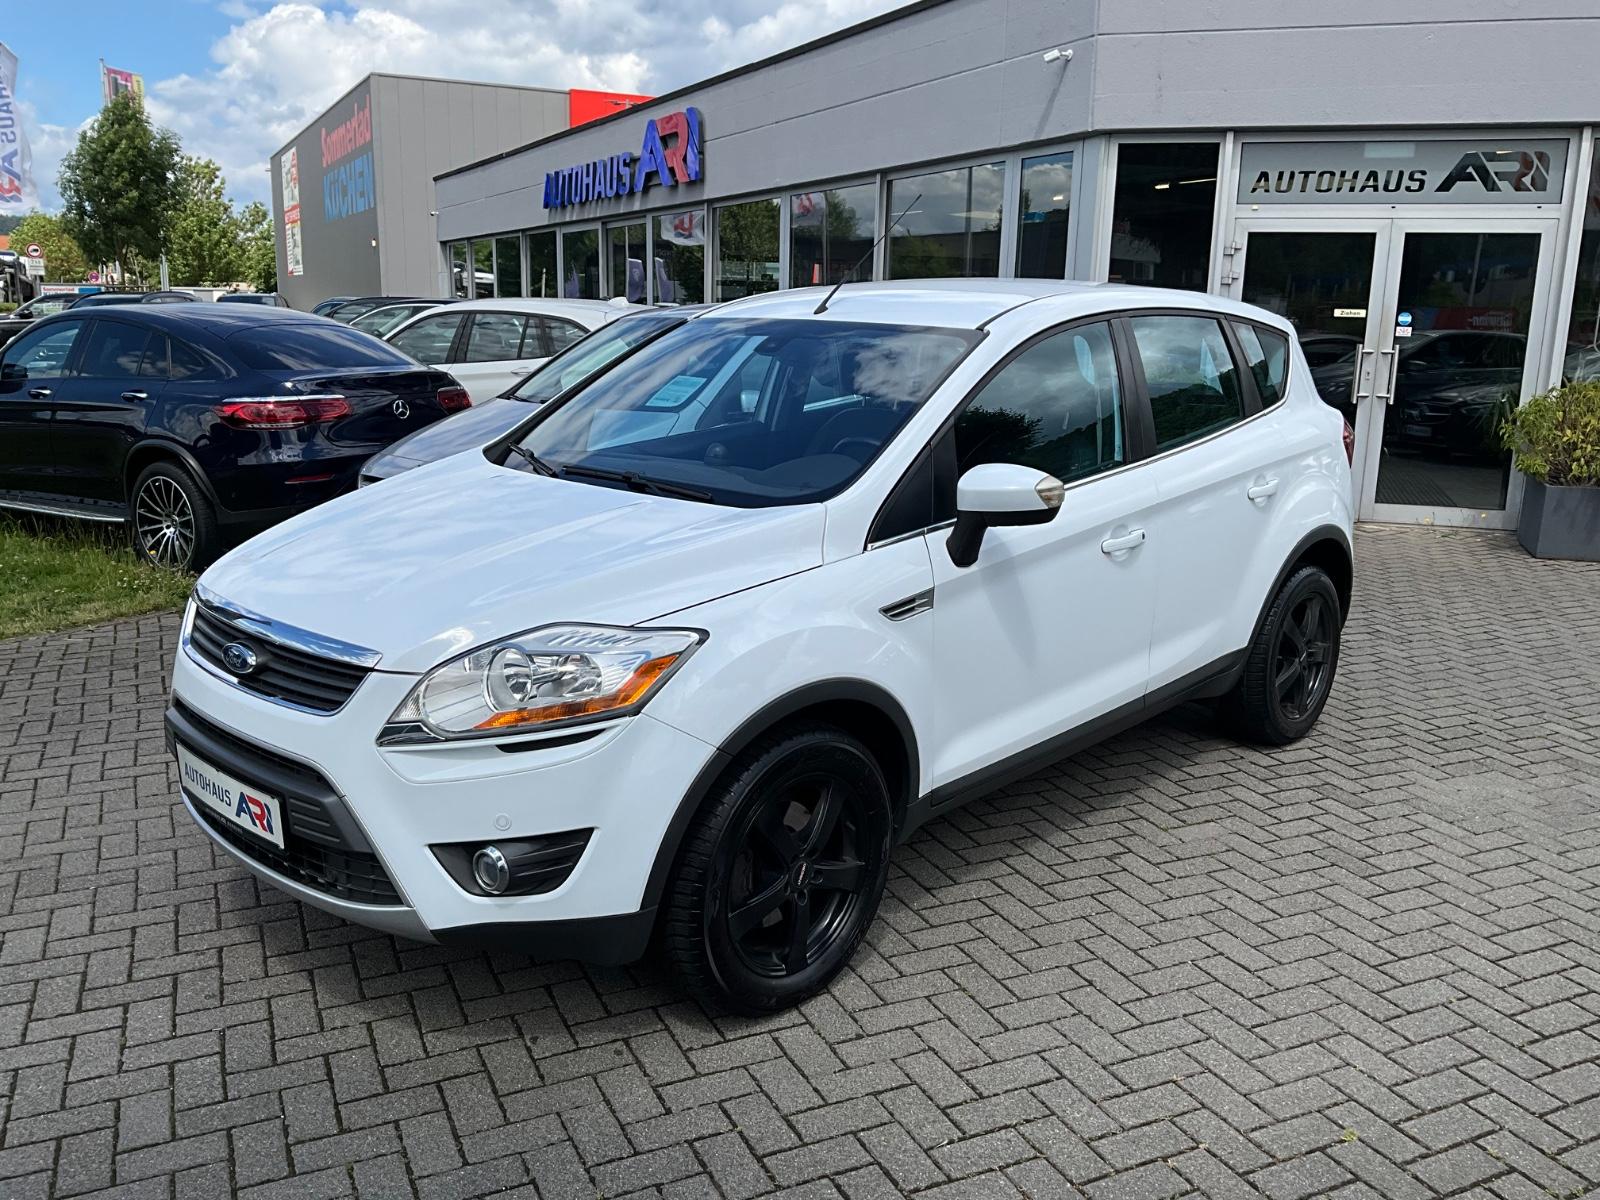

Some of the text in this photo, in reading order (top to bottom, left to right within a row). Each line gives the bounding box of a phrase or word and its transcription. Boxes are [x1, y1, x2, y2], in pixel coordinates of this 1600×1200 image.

[321, 94, 371, 168] Sommerlad
[543, 106, 700, 209] AUTOHAUS ARI
[322, 150, 375, 224] KÜCHEN
[1250, 150, 1551, 194] AUTOHAUS ARI
[184, 761, 232, 807] AUTOHAUS
[235, 791, 275, 836] ARI
